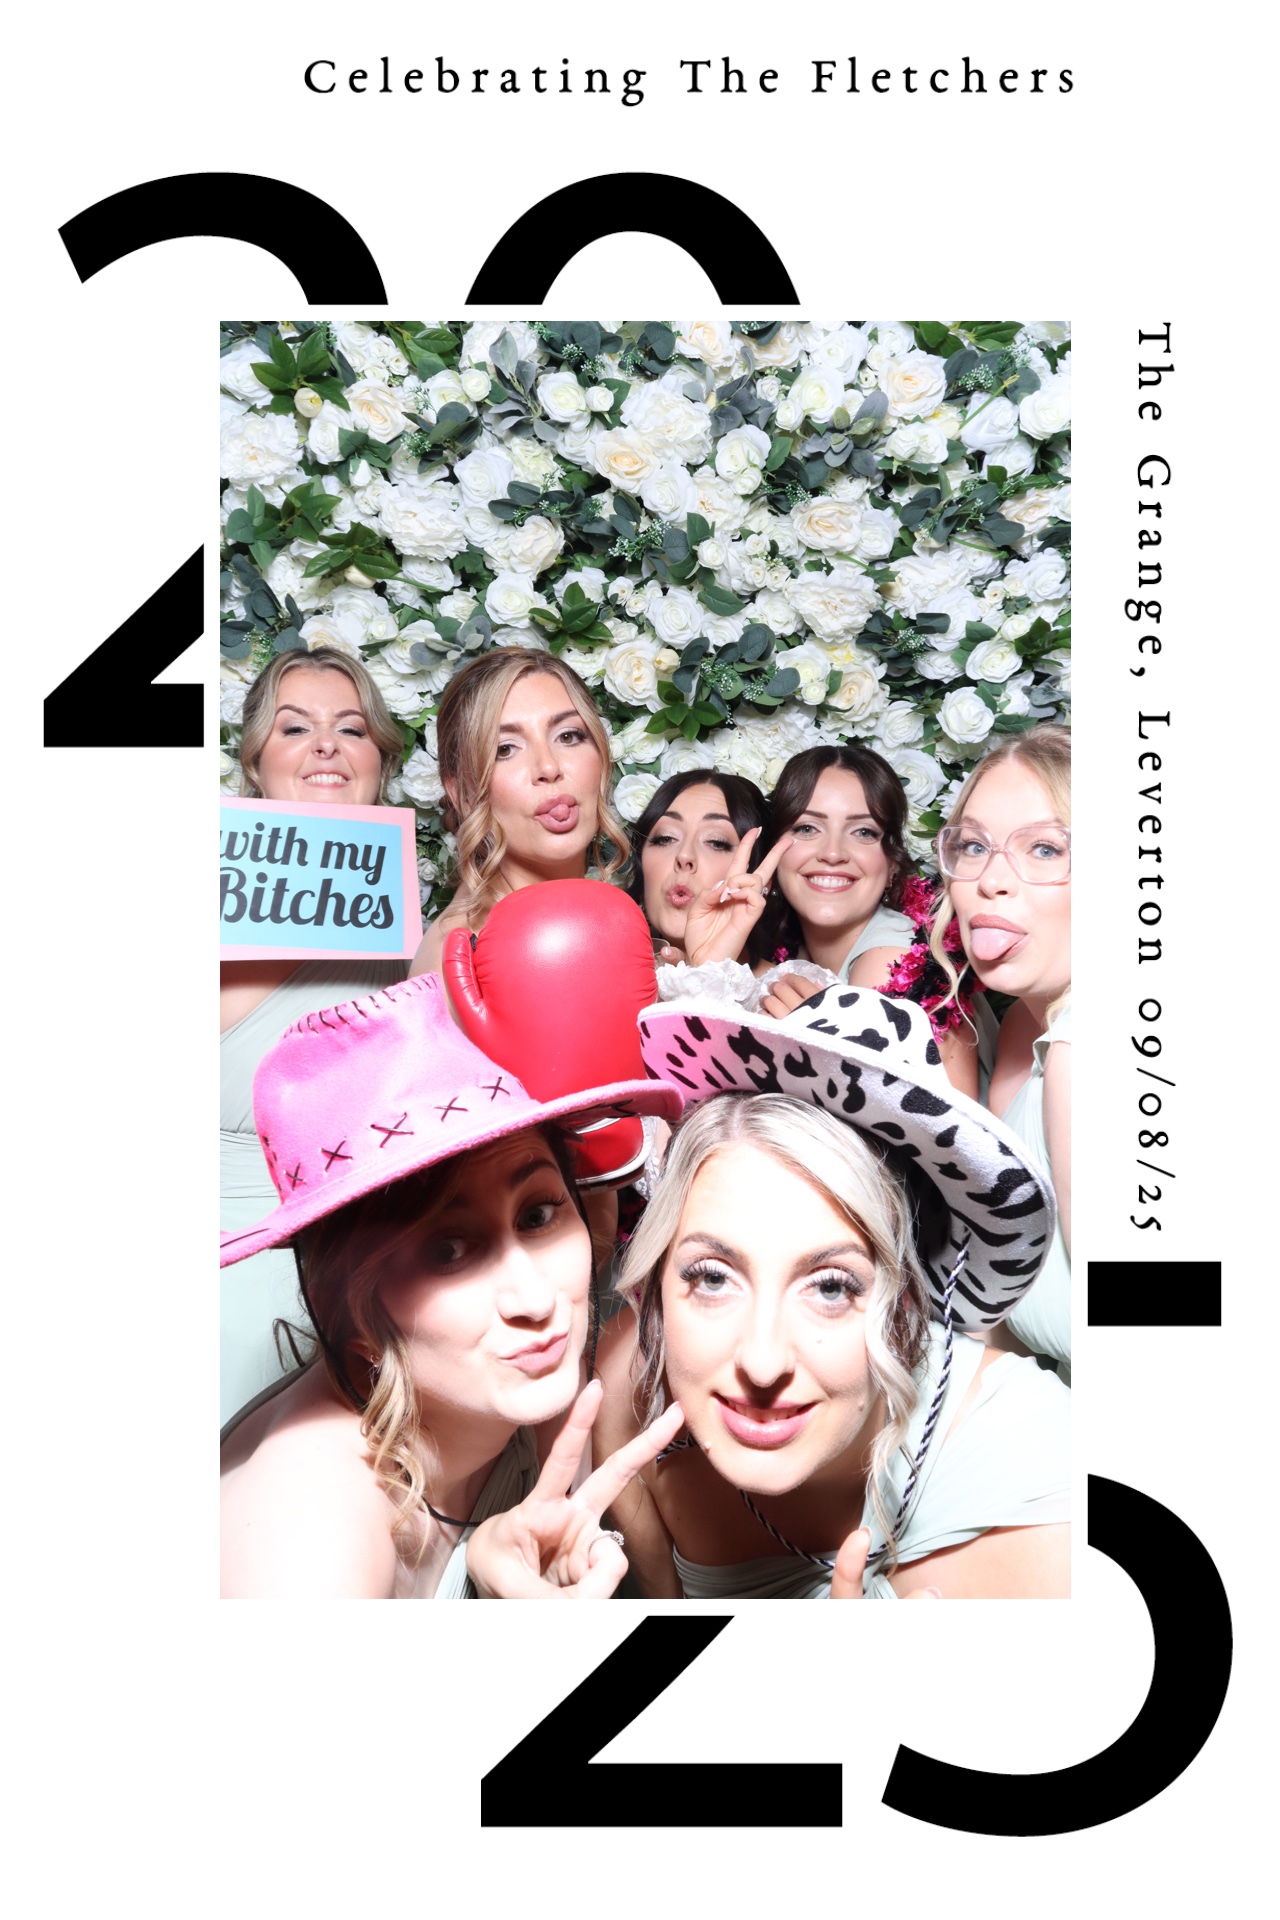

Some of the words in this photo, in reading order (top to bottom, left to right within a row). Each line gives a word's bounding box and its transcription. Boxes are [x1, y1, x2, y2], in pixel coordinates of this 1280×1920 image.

[220, 822, 309, 867] with
[319, 840, 387, 886] my
[220, 866, 394, 930] Bitches
